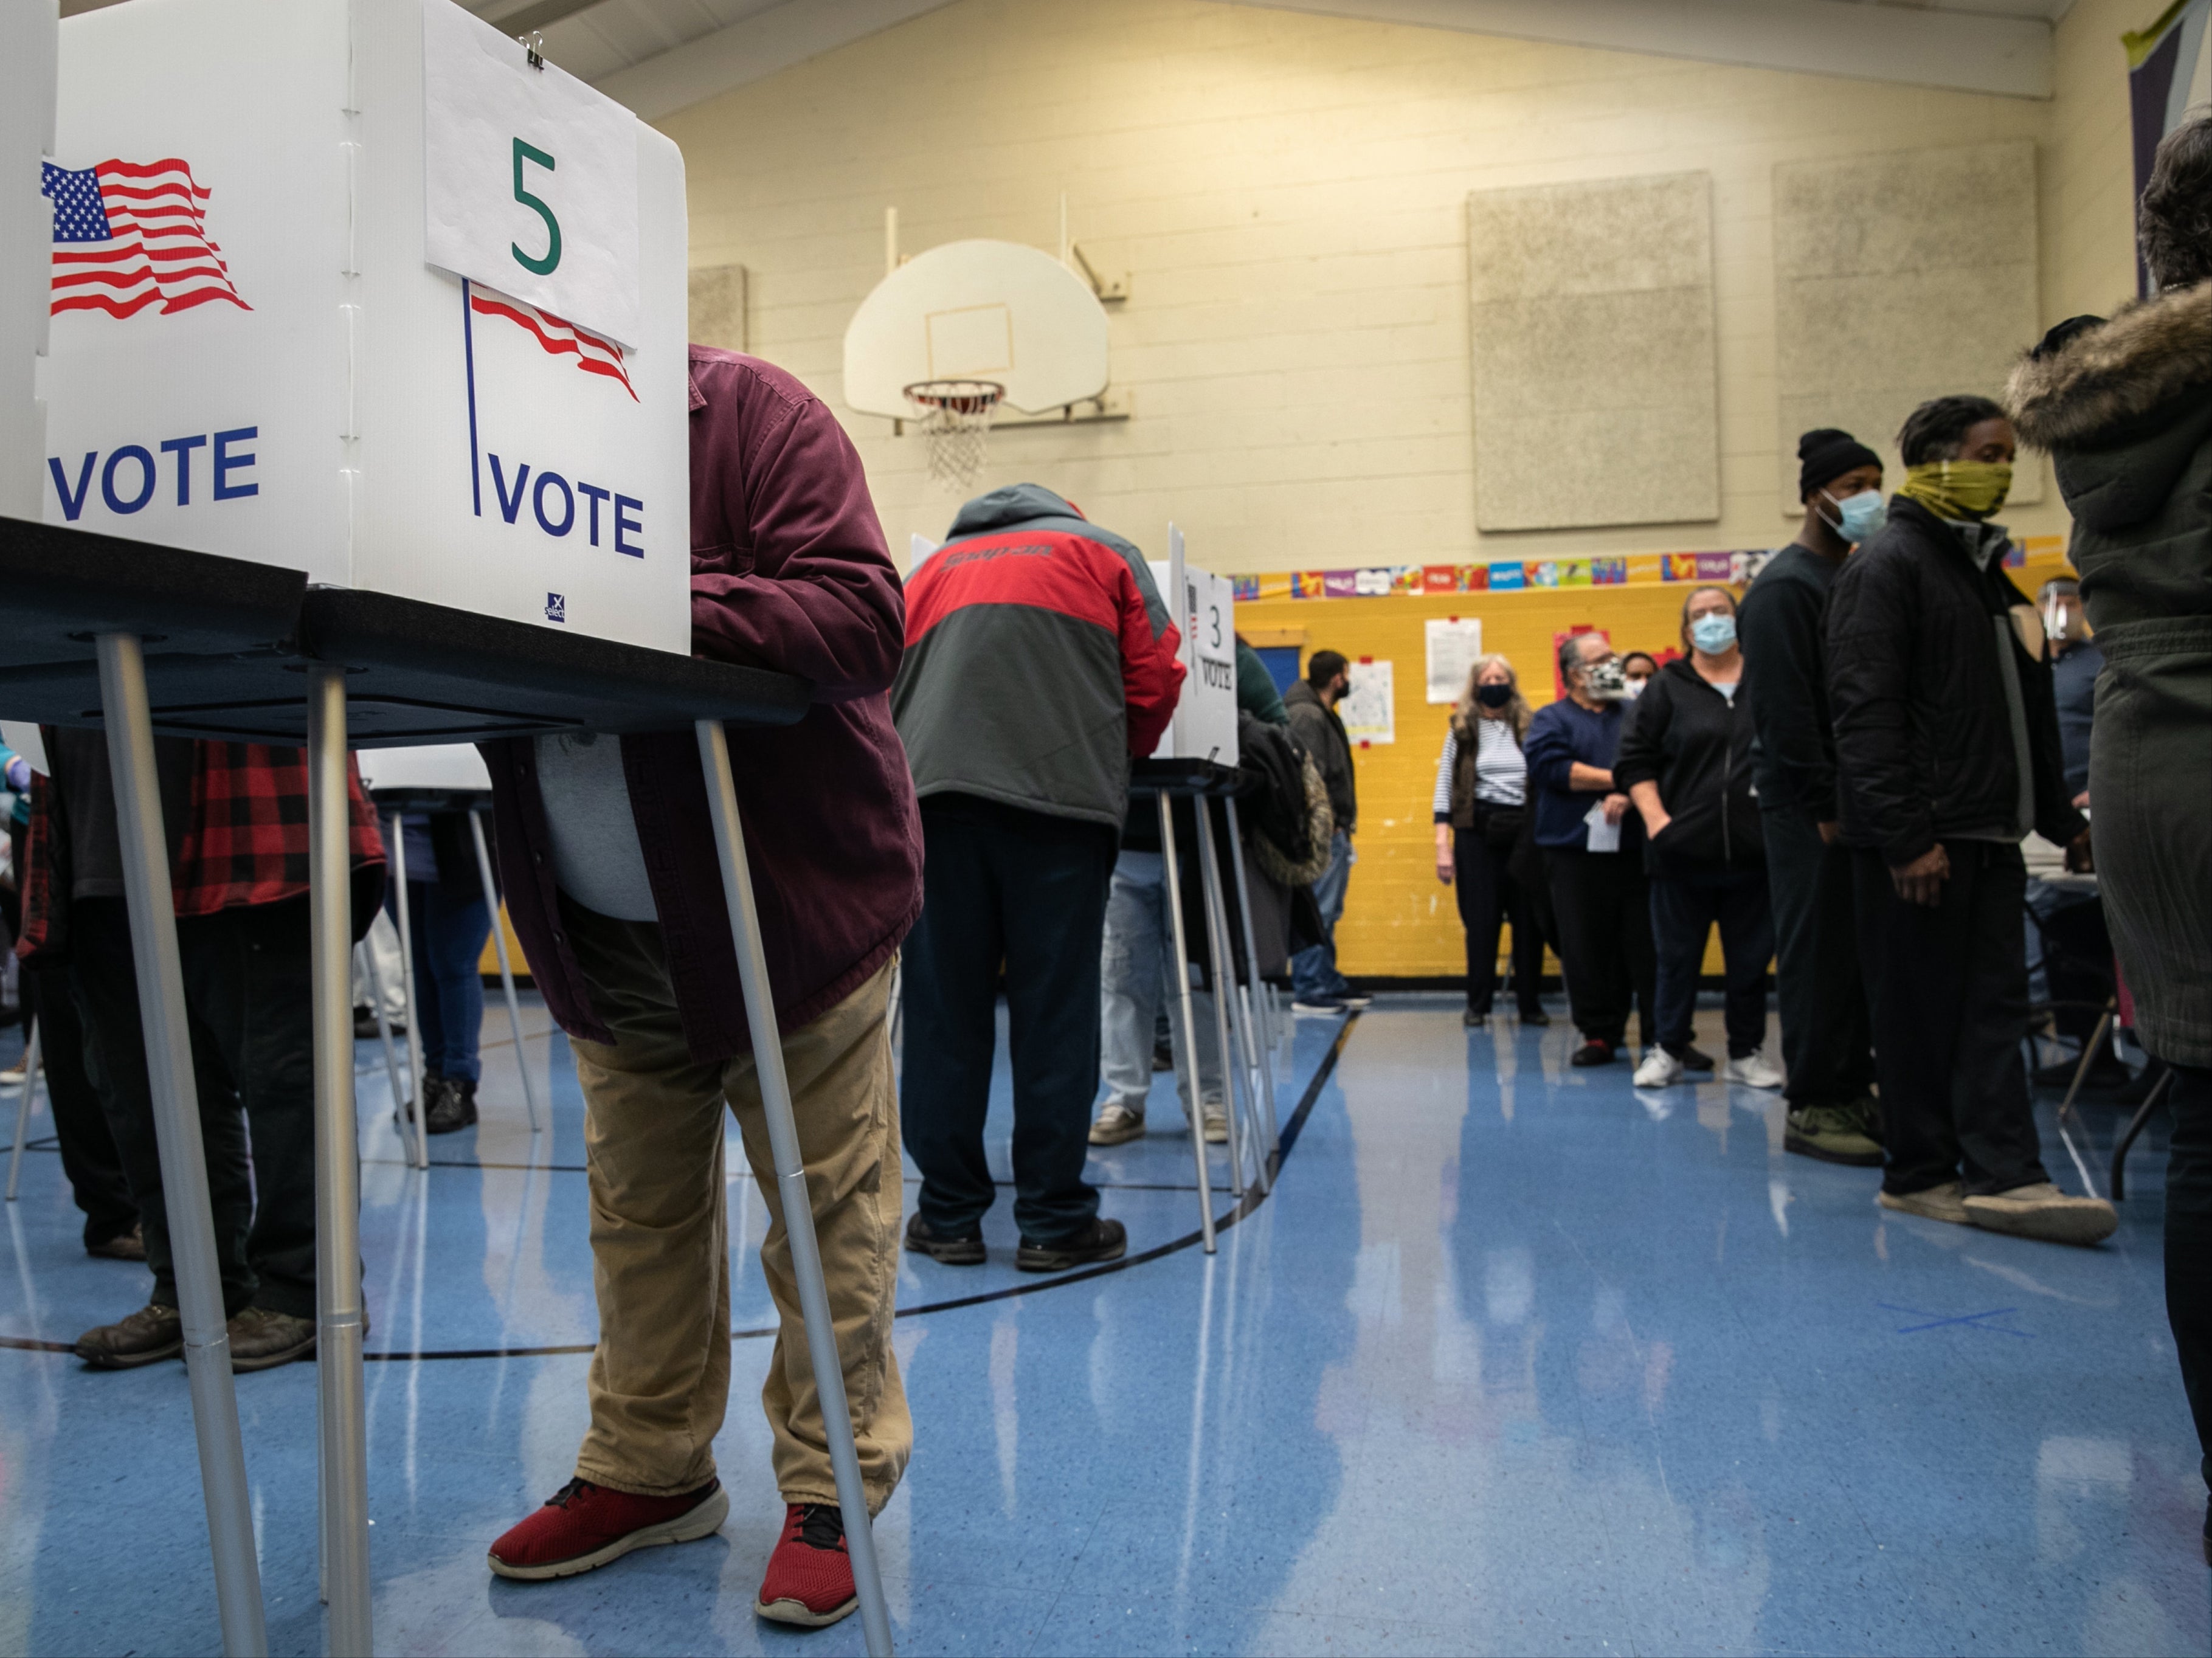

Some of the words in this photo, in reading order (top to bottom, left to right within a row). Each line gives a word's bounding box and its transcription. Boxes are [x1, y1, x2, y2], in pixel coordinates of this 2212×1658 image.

[512, 137, 561, 275] 5
[47, 426, 258, 522] VOTE
[488, 452, 645, 559] VOTE
[544, 605, 565, 618] select
[1210, 606, 1222, 649] 3
[1201, 657, 1232, 691] VOTE
